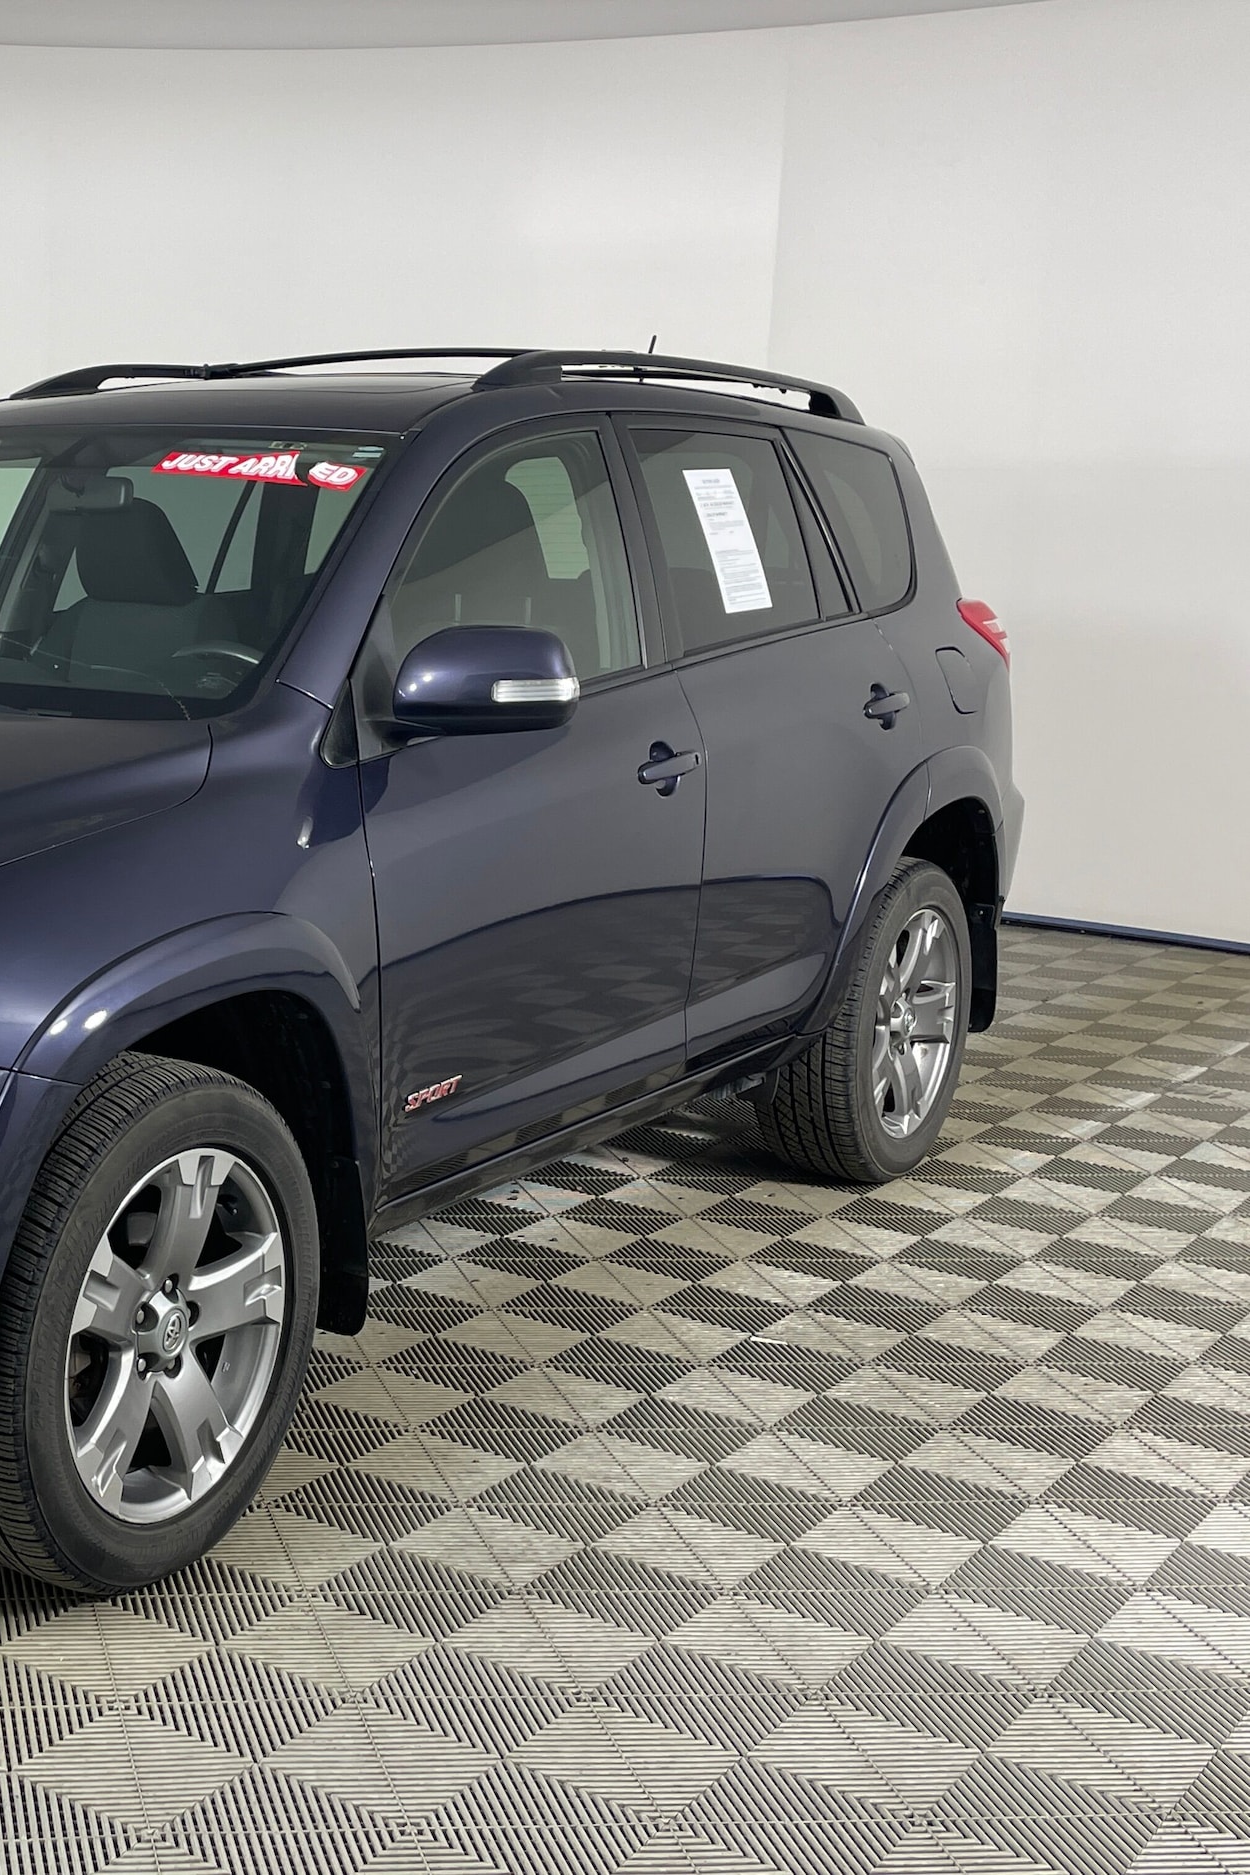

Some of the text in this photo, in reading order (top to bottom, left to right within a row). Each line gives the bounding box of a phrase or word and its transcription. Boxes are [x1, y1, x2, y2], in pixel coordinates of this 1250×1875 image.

[161, 452, 358, 486] JUST ARRIED
[405, 1074, 463, 1112] SPORT
